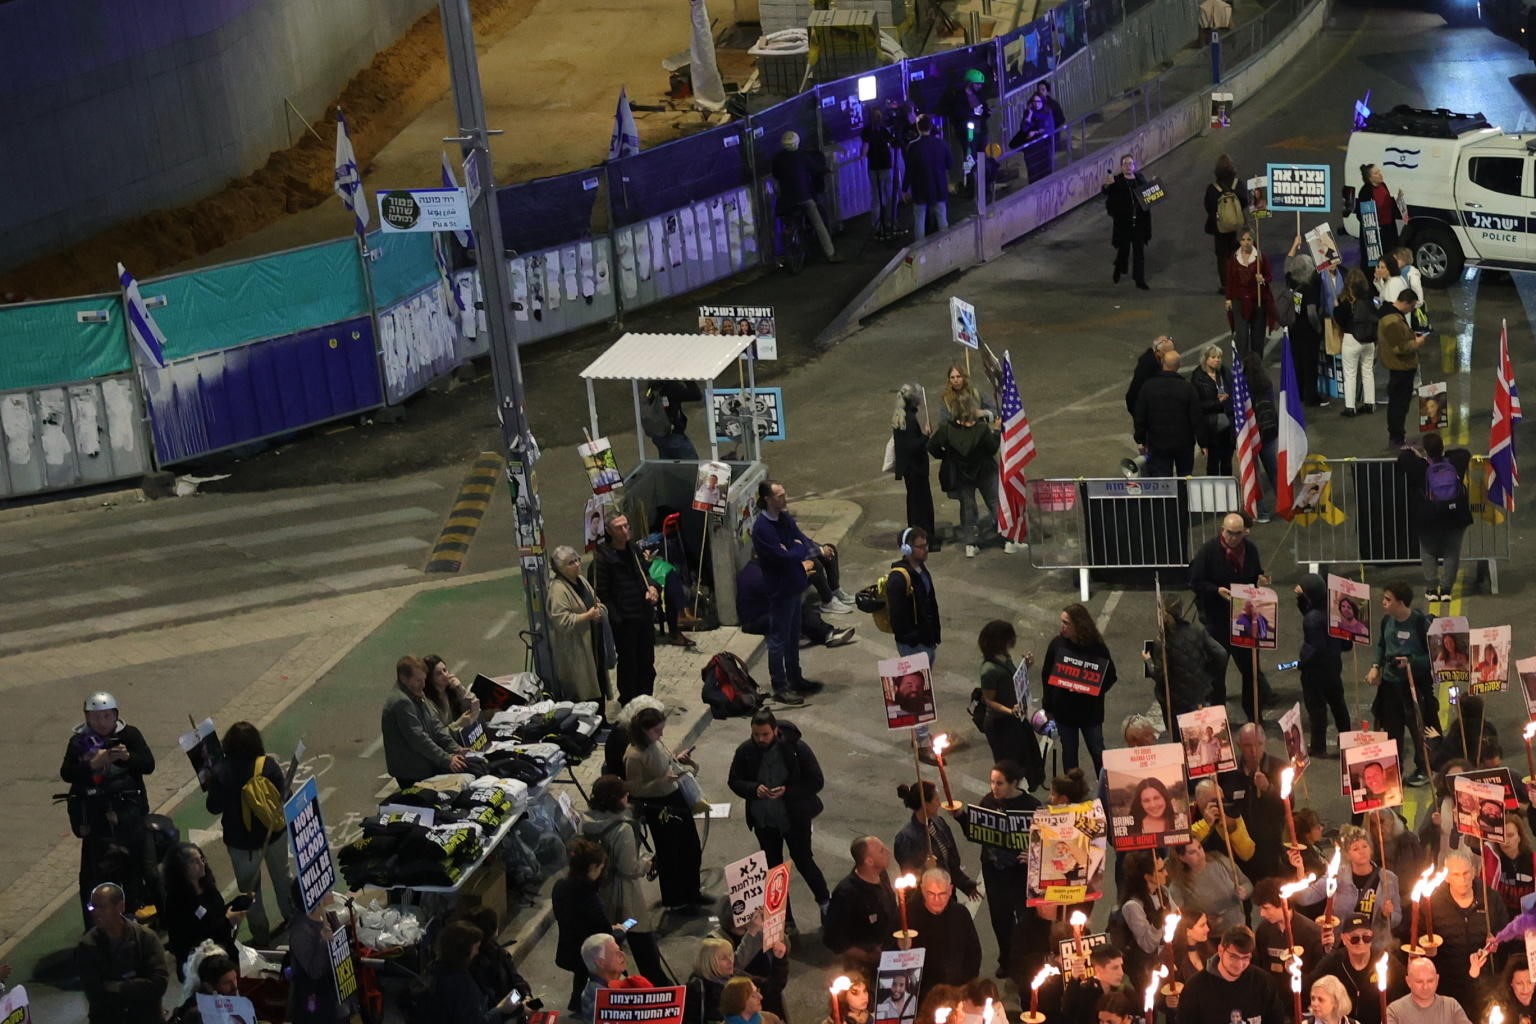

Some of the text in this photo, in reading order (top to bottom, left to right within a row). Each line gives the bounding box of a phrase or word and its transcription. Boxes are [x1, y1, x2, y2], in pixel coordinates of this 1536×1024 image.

[1273, 169, 1325, 182] עצרו את
[1273, 181, 1325, 195] המלחמה
[1471, 211, 1519, 231] ישראל
[1482, 231, 1517, 243] POLICE
[737, 307, 772, 318] זועקות
[293, 801, 315, 831] HOW
[1113, 815, 1135, 827] BRING
[294, 816, 320, 851] MUCH
[1113, 826, 1128, 837] HER
[298, 832, 324, 868] BLOOD
[302, 853, 330, 891] WILL BE
[738, 857, 760, 878] לא
[305, 867, 334, 907] SPILLED?
[729, 870, 768, 896] למלחמת
[743, 884, 764, 902] נצח
[609, 992, 672, 1005] תמונת הניצחון
[601, 1007, 681, 1021] היא החטוף האחרון
